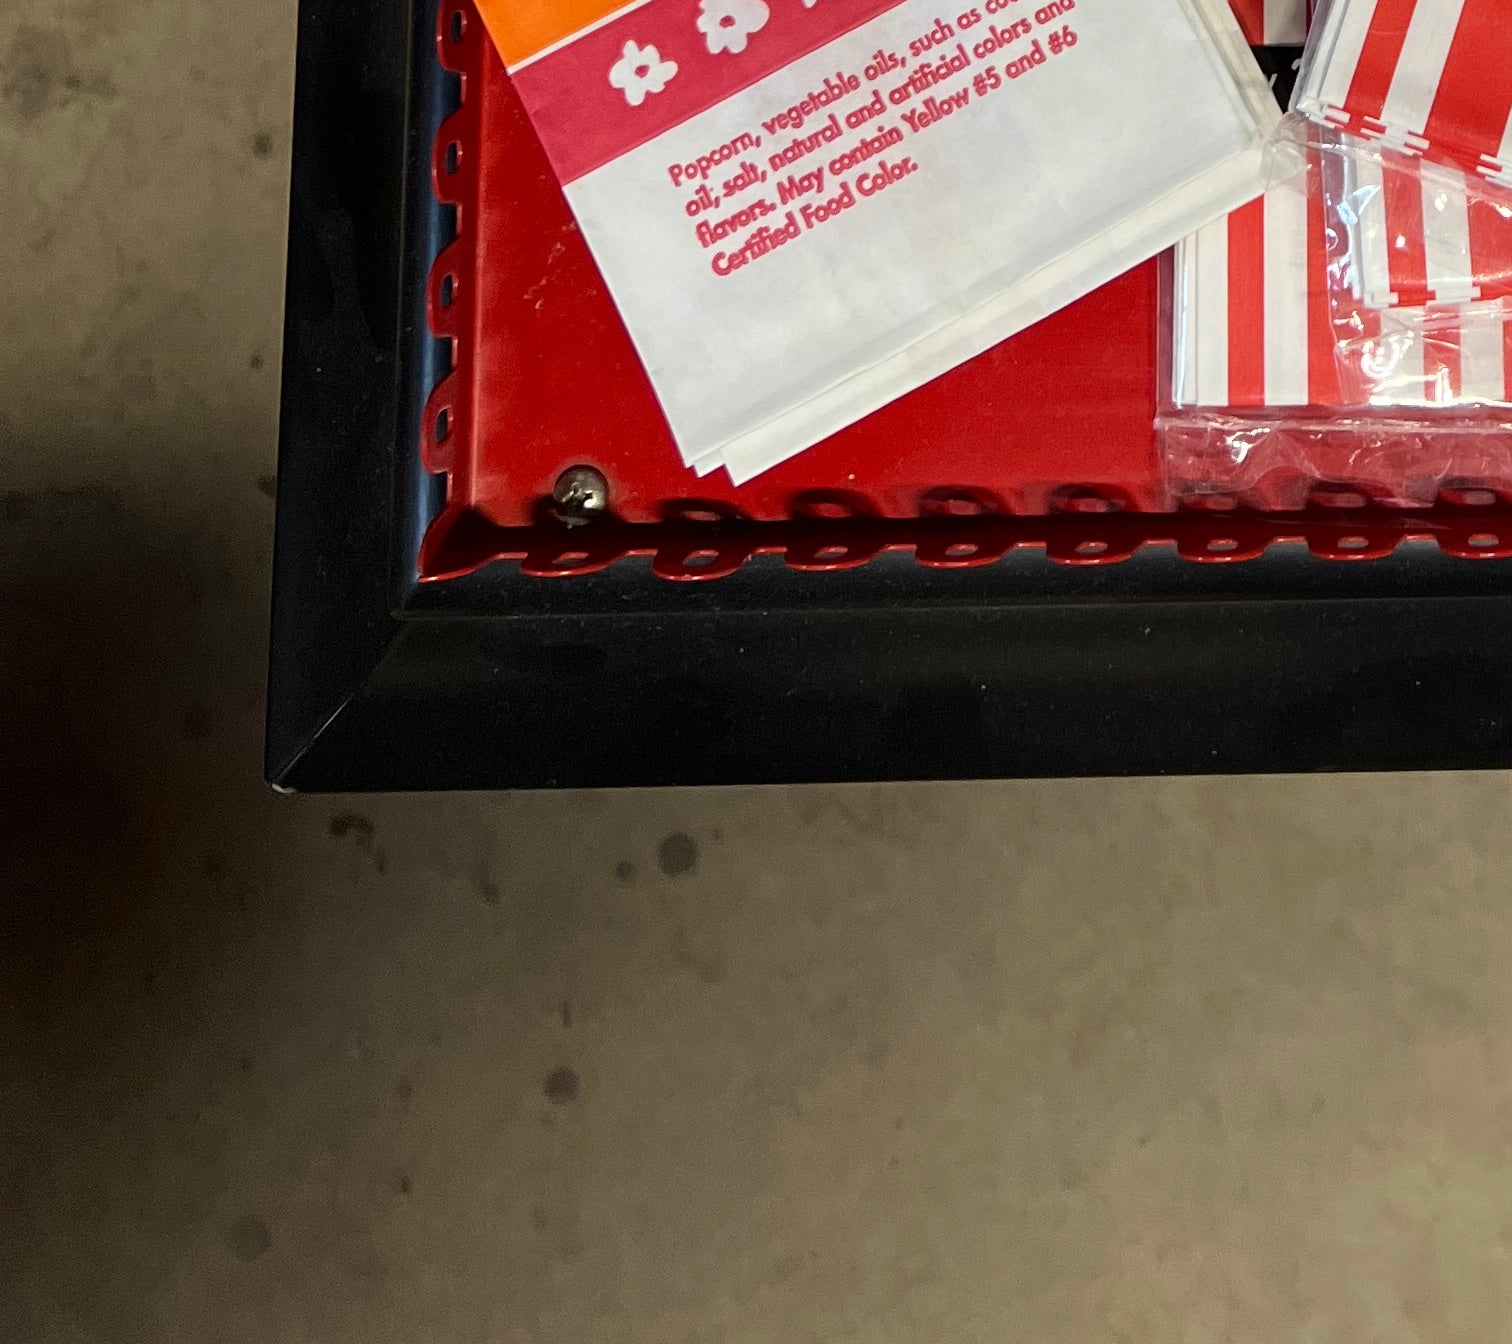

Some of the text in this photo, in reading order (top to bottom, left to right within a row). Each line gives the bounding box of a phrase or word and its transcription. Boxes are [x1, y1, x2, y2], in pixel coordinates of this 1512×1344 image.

[668, 130, 764, 187] Popcorn,
[762, 72, 861, 133] vegetable
[864, 49, 907, 81] oils,
[909, 20, 954, 57] such
[957, 8, 982, 31] as
[684, 184, 722, 218] oil,
[722, 161, 768, 198] salt,
[768, 114, 843, 173] natural
[846, 89, 887, 129] and
[889, 44, 971, 105] artificial
[973, 15, 1033, 59] colors
[695, 25, 1078, 249] flavors. May contain Yellow #5 and #6
[711, 154, 919, 278] Certified Food Color.
